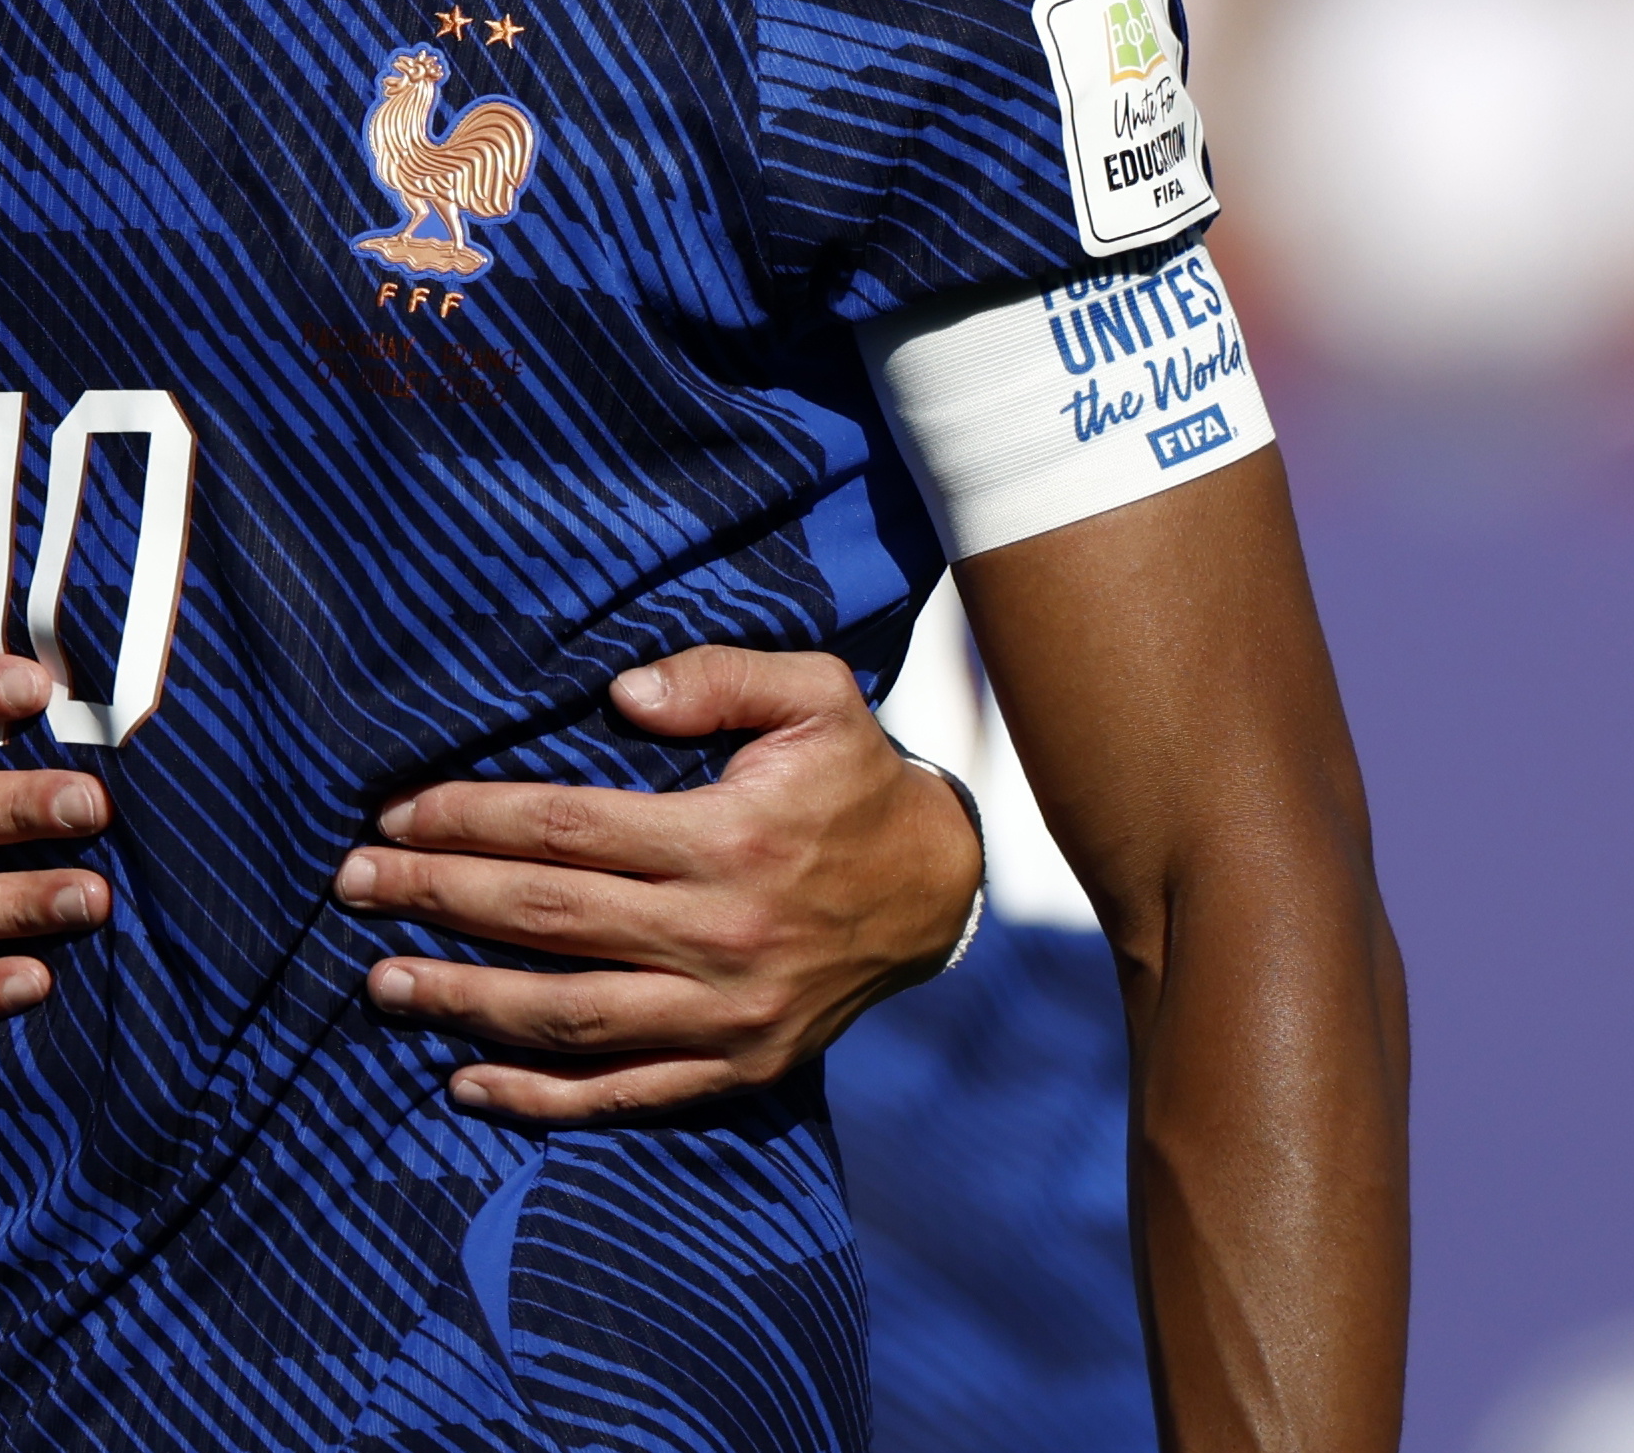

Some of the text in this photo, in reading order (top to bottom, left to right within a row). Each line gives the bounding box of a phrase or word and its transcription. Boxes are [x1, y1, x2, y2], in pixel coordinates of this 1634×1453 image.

[1114, 75, 1177, 141] Unite For
[1103, 122, 1188, 193] EDUCATION
[1153, 178, 1185, 209] FIFA
[1049, 257, 1223, 375] UNITES
[1060, 318, 1246, 443] the World
[1155, 414, 1227, 461] FIFA
